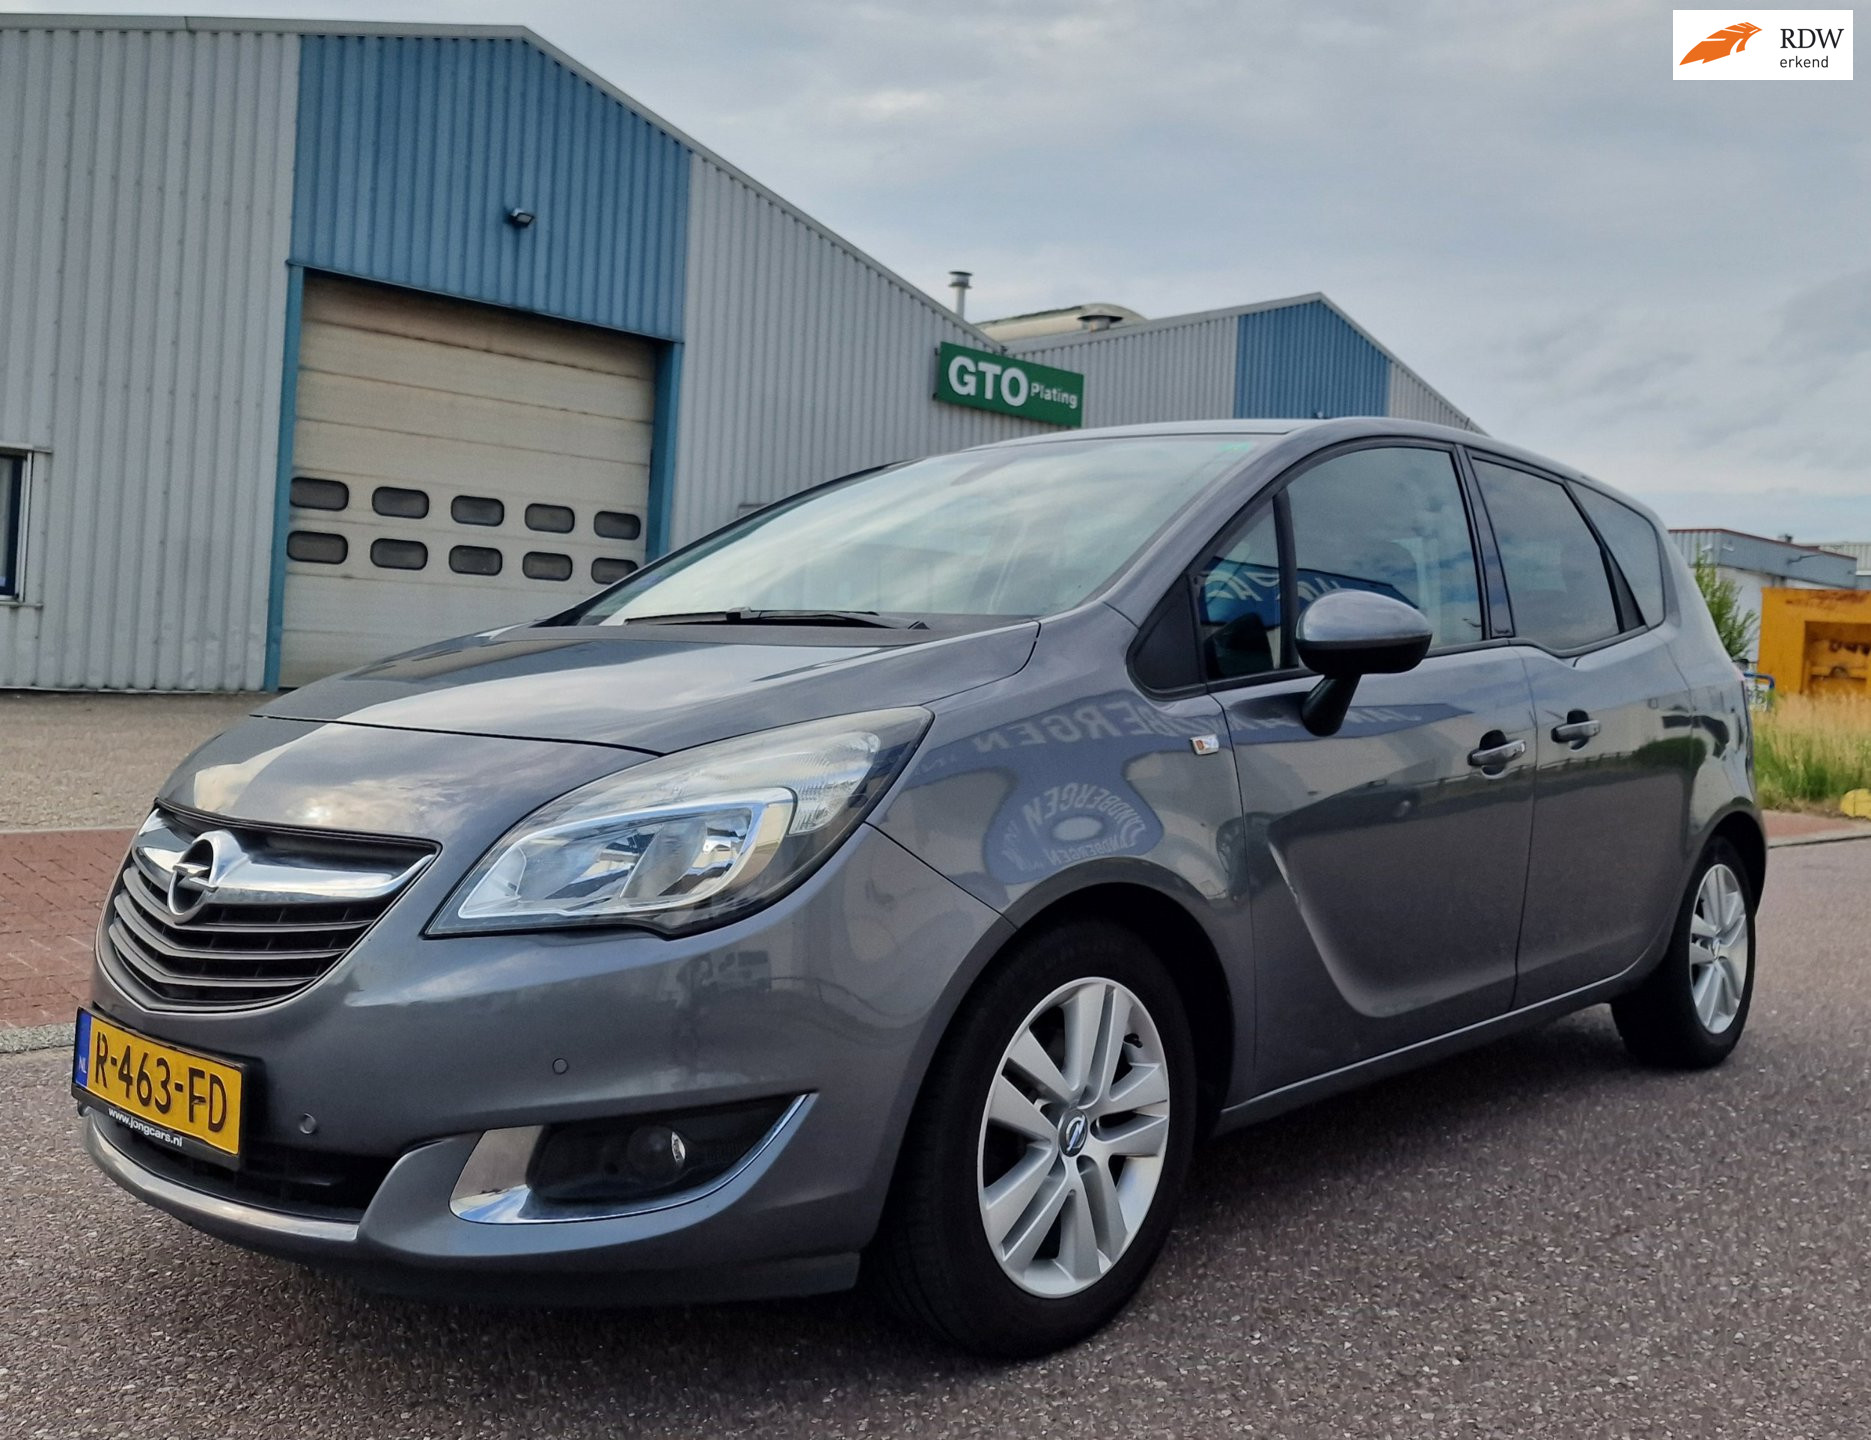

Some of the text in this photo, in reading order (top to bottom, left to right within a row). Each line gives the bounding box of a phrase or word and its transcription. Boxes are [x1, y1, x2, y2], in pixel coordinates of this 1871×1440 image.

[948, 355, 1078, 409] GTO Plating
[79, 1056, 87, 1074] NL
[95, 1031, 227, 1133] R-463-FD
[108, 1107, 183, 1147] www.jongcars.nl
